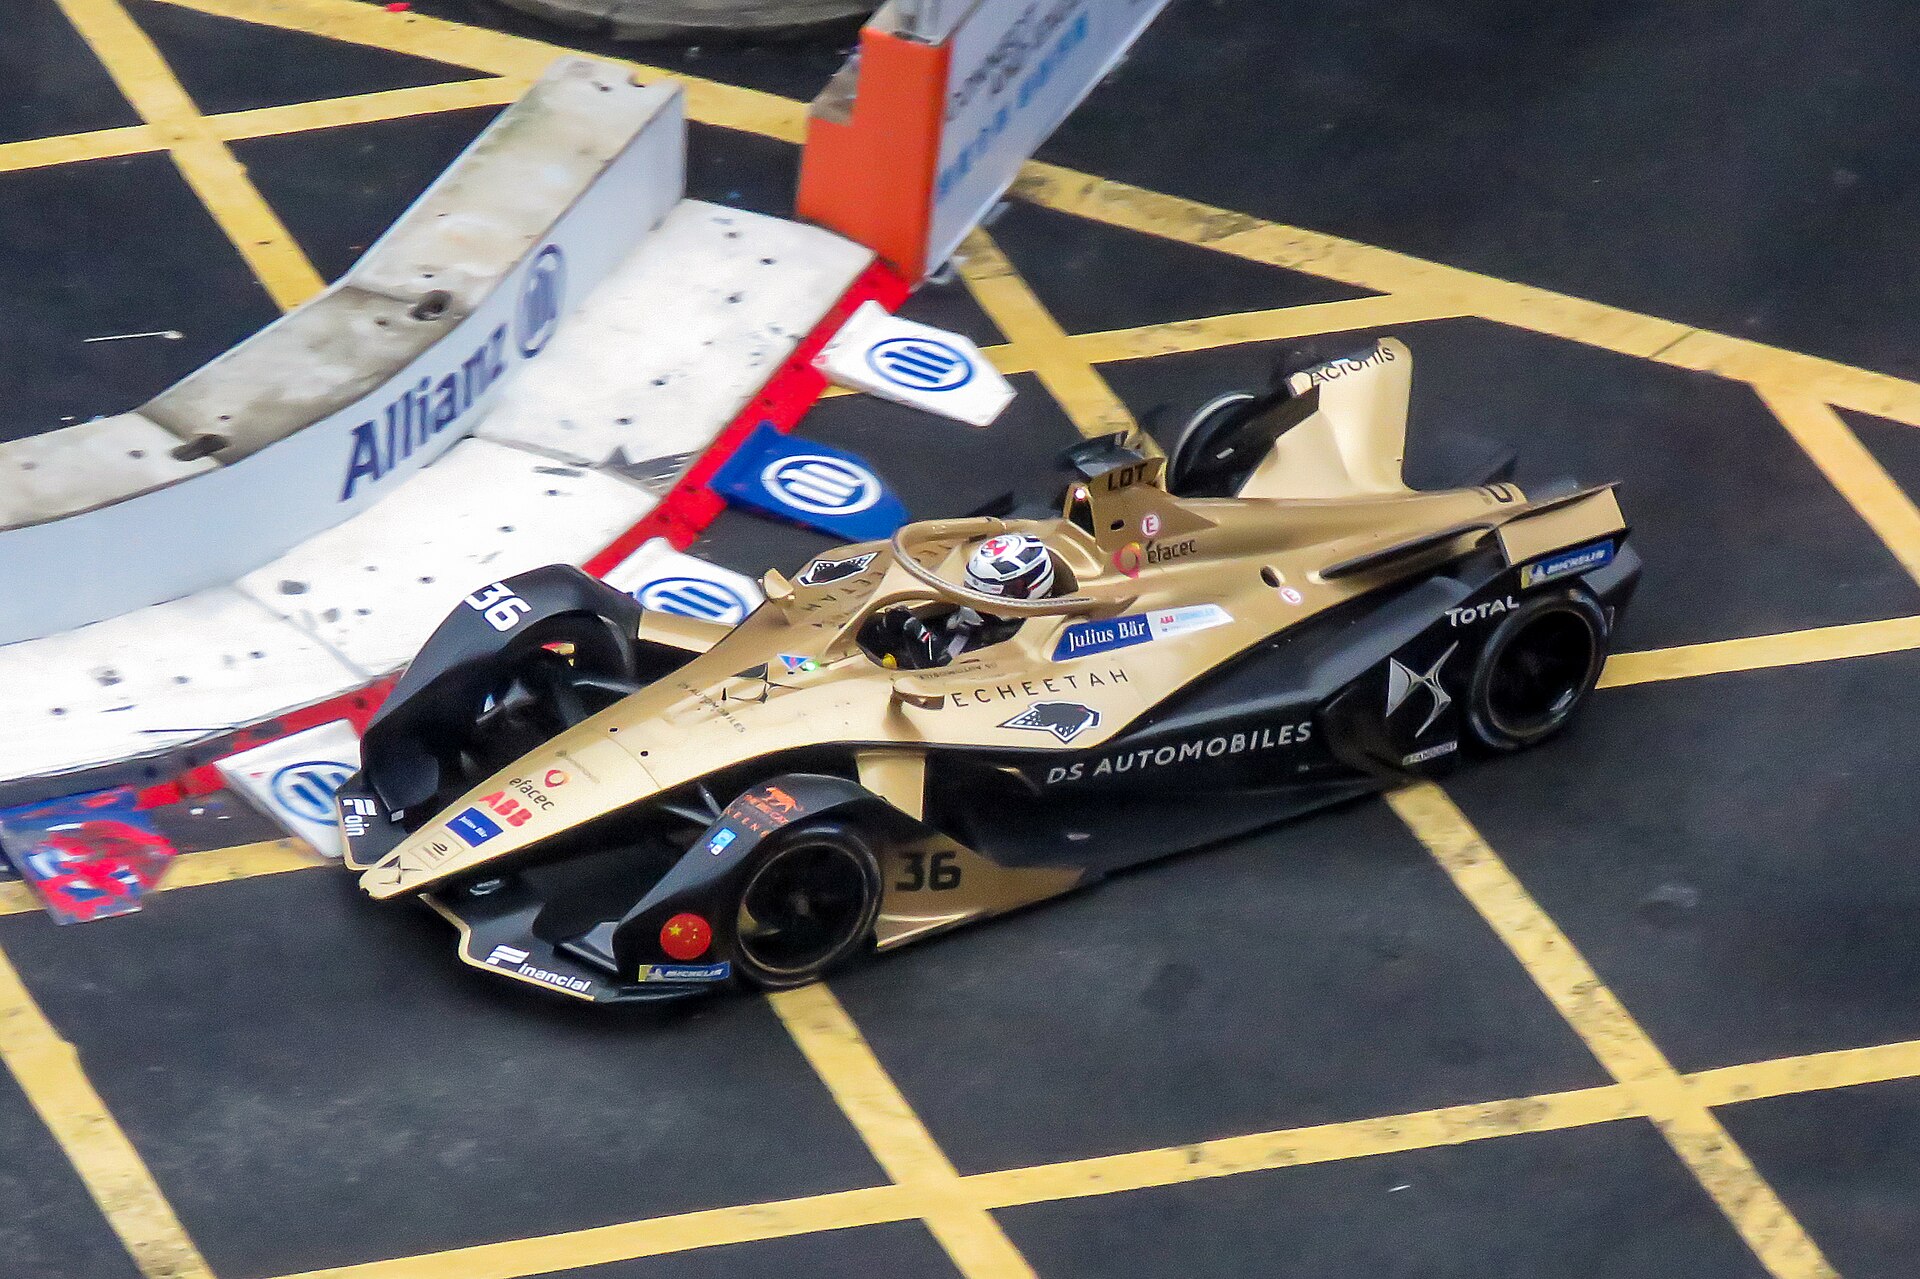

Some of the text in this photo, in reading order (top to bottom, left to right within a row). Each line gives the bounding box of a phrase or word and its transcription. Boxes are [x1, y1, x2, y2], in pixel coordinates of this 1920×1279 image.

[337, 322, 507, 502] Allianz
[463, 582, 532, 632] 36
[1444, 595, 1520, 627] TOTAL
[1068, 620, 1146, 653] Julius Bär
[1046, 721, 1313, 784] DS AUTOMOBILES
[478, 791, 533, 827] ABB
[508, 777, 555, 811] efacec
[895, 851, 962, 892] 36
